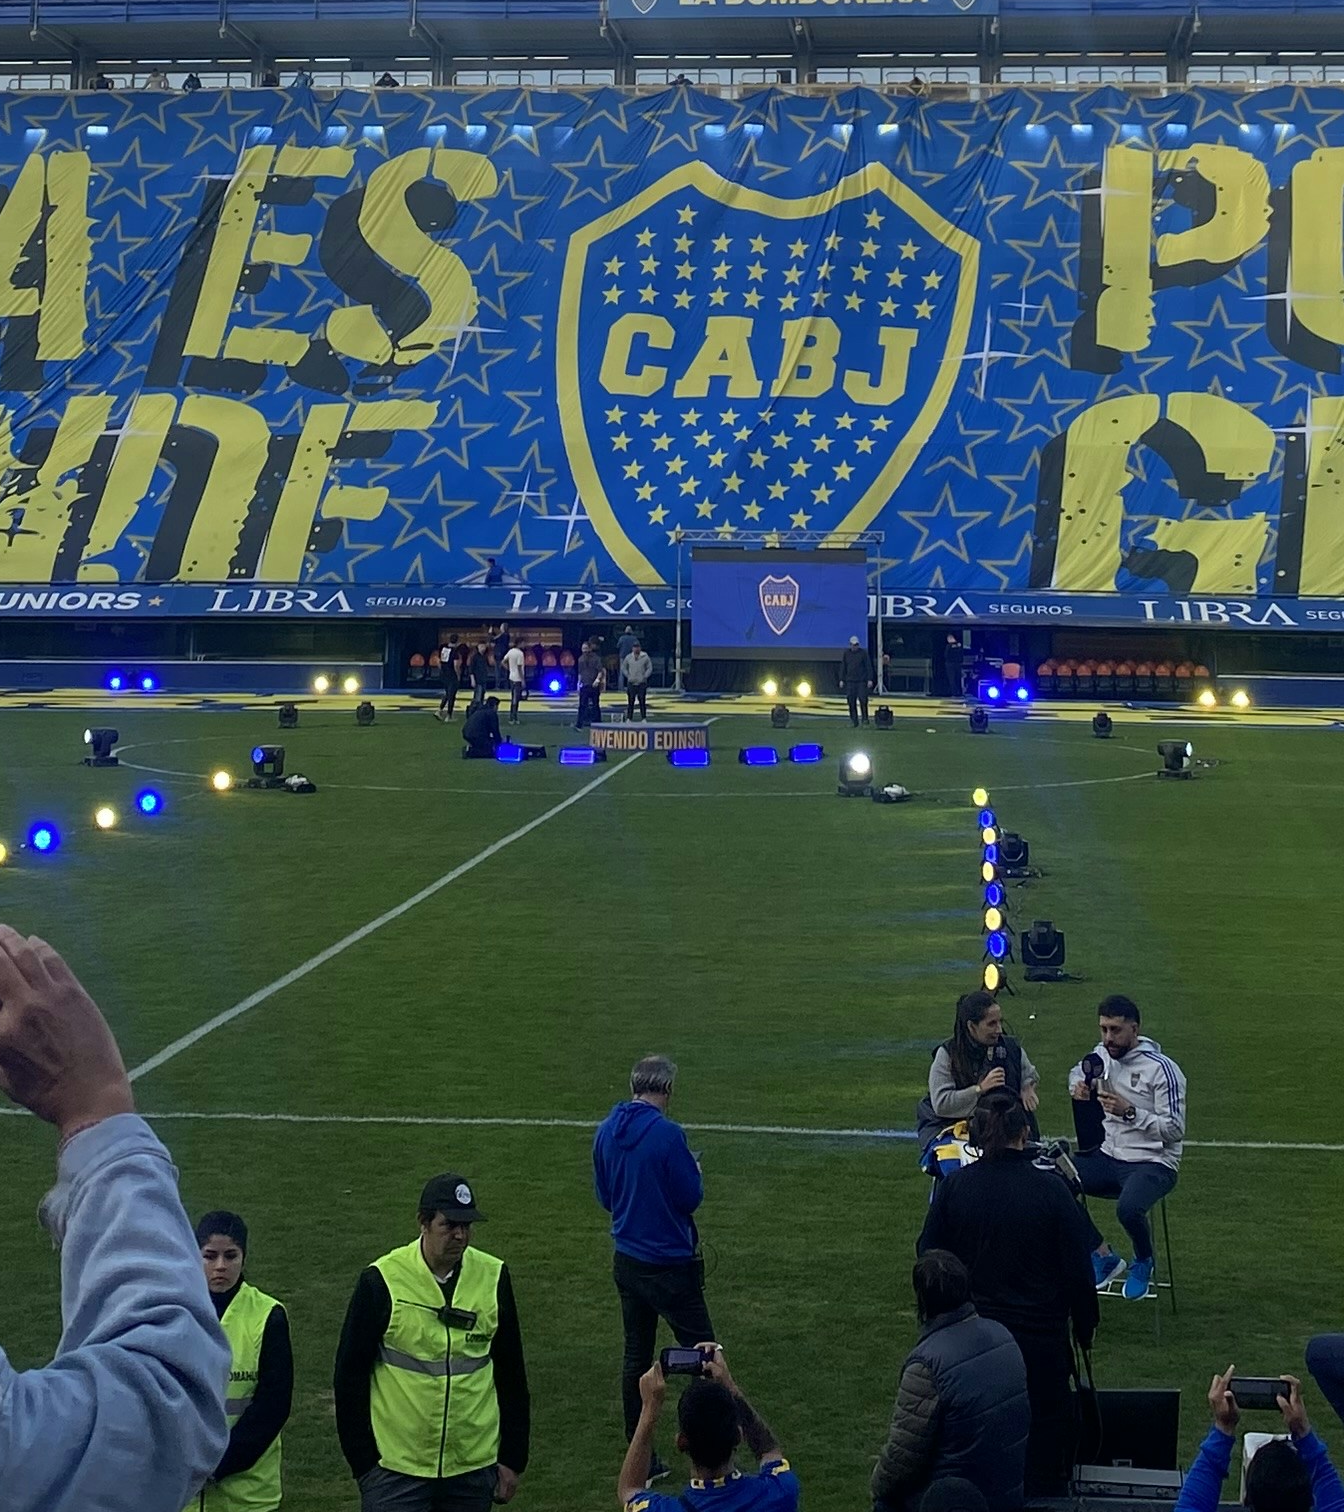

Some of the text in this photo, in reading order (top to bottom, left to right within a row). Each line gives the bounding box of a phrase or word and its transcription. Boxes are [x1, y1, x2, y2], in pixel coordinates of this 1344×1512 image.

[182, 144, 497, 365] ES
[598, 312, 920, 406] CABJ
[206, 589, 446, 613] LIBRA SEGUROS
[506, 591, 655, 615] LIBRA
[989, 603, 1072, 616] SEGUROS
[1138, 601, 1299, 626] LIBRA
